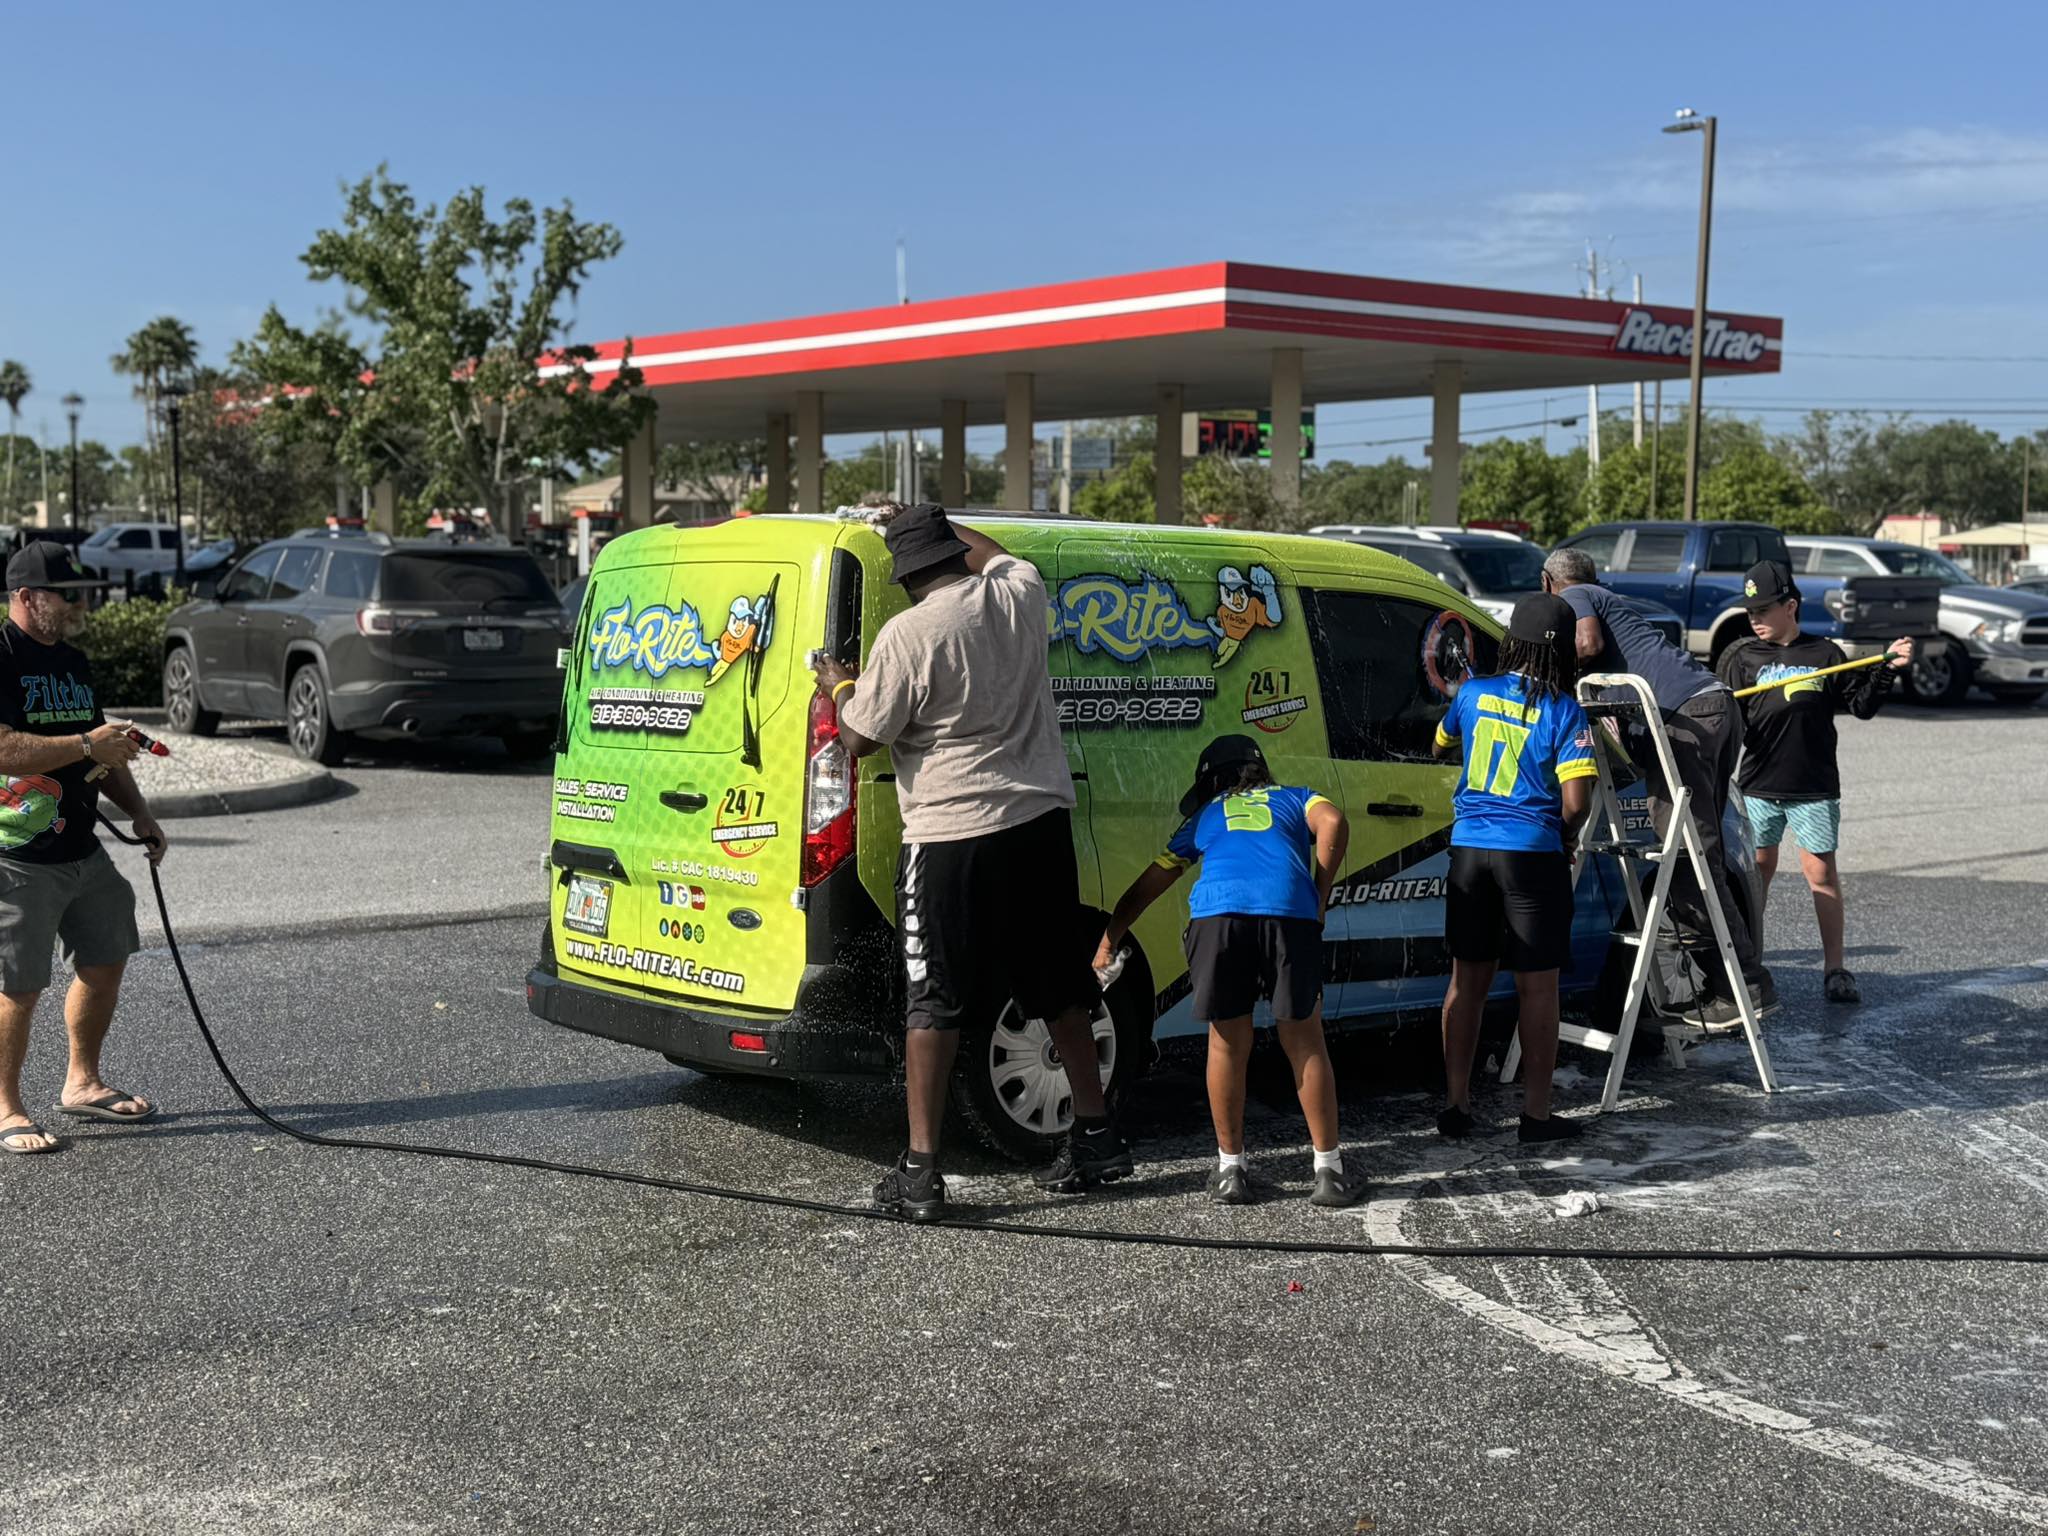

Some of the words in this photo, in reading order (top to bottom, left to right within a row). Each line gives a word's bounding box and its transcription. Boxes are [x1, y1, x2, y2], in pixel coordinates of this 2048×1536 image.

[1617, 310, 1766, 362] RaceTrac
[1046, 580, 1214, 656] -Rite
[590, 605, 713, 673] Flo-Rite
[589, 688, 602, 699] AIR
[602, 688, 655, 701] CONDITIONING
[655, 690, 663, 702] &
[664, 690, 704, 704] HEATING
[1136, 676, 1147, 690] &
[1151, 676, 1215, 690] HEATING
[591, 704, 692, 730] 813-380-9622
[1242, 703, 1280, 722] EMERGENCY
[1279, 697, 1306, 713] SERVICE
[1467, 716, 1531, 798] 17
[556, 779, 580, 795] SALES
[585, 781, 628, 801] SERVICE
[1223, 792, 1273, 832] 5
[651, 857, 669, 872] Lic.
[671, 859, 679, 873] #
[681, 861, 704, 876] CAC
[706, 866, 759, 886] 1819430
[565, 938, 745, 992] www.FLO-RITEAC.com
